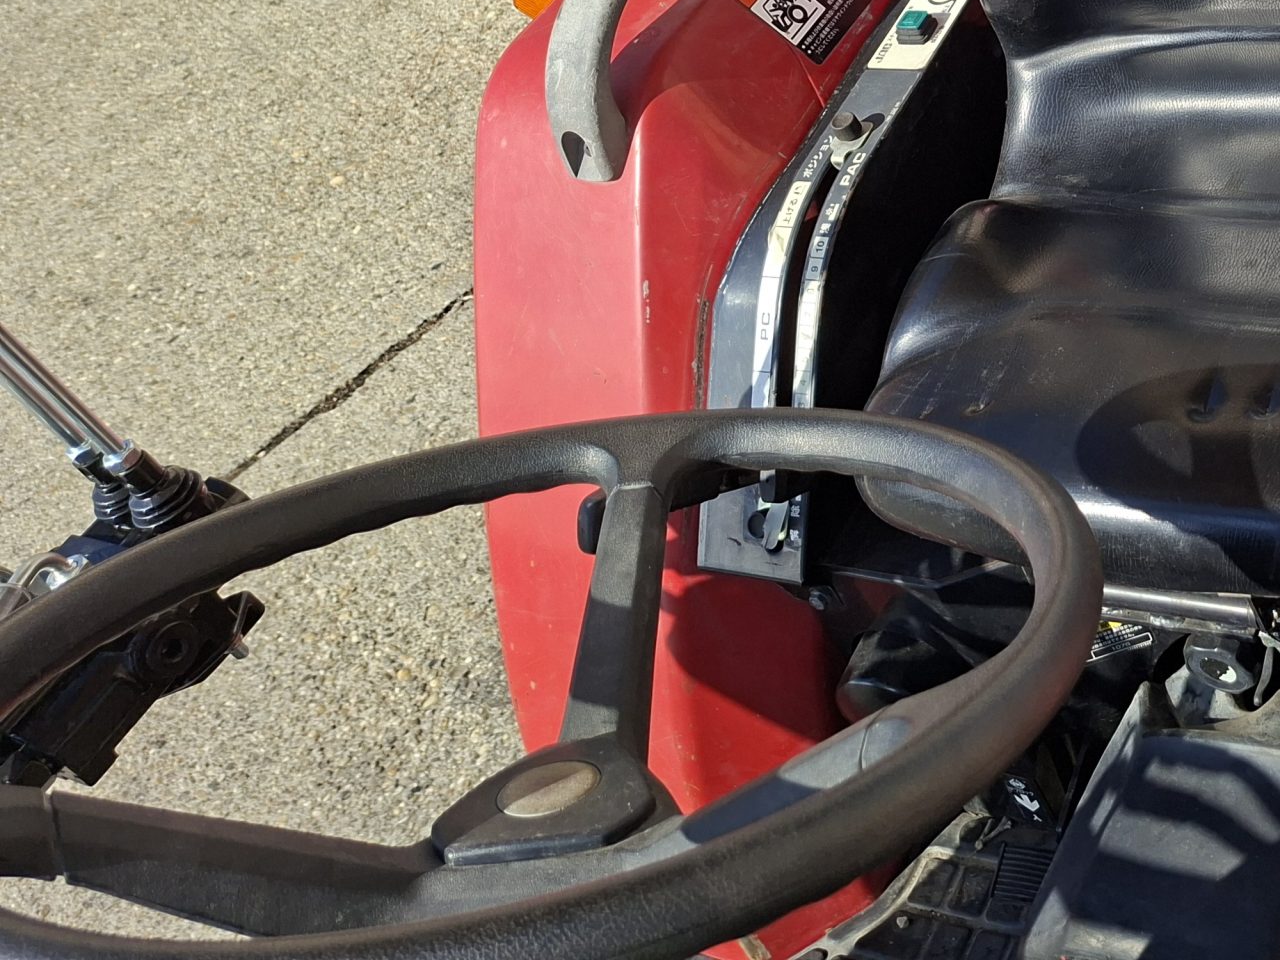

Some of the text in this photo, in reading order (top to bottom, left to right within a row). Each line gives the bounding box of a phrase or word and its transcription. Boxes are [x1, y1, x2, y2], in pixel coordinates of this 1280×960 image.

[803, 135, 834, 178] ポジション
[839, 152, 867, 186] PAC
[782, 198, 798, 224] 上げる
[815, 241, 825, 253] 10
[760, 312, 771, 341] PC
